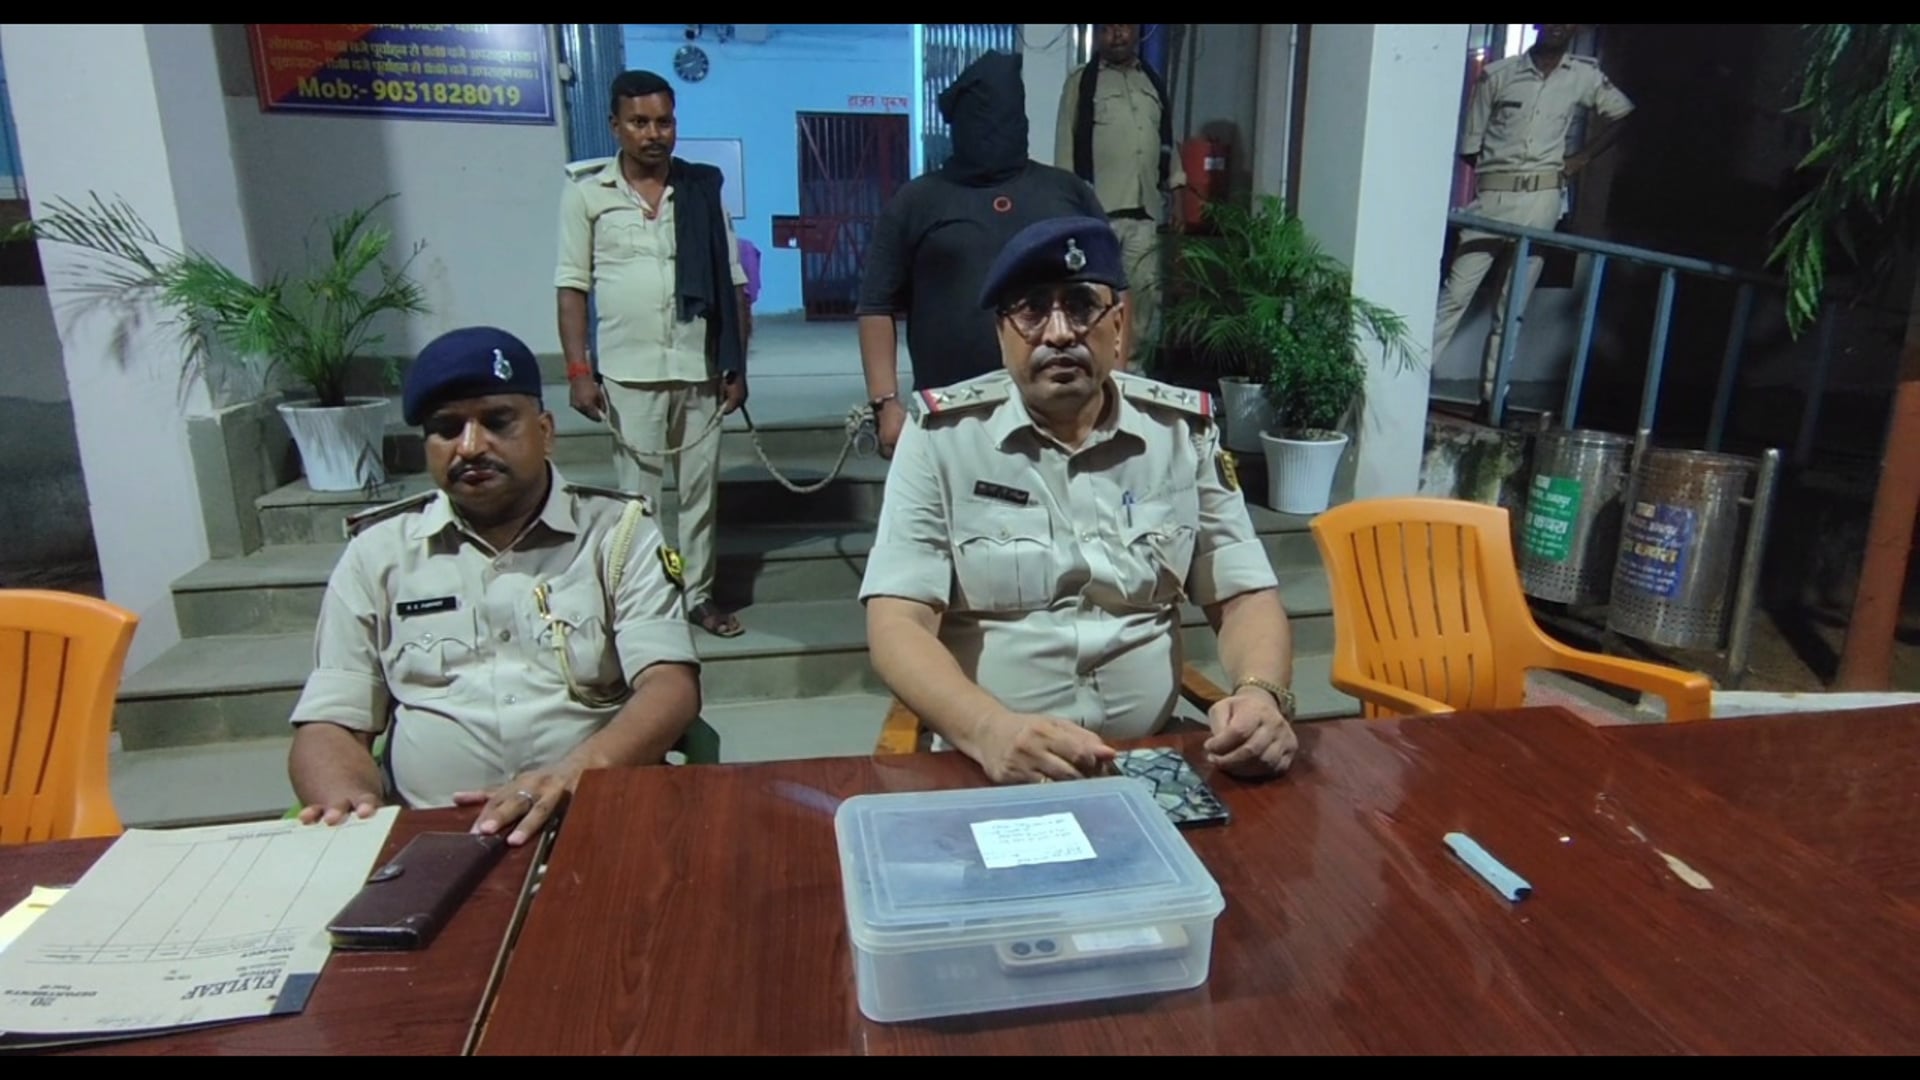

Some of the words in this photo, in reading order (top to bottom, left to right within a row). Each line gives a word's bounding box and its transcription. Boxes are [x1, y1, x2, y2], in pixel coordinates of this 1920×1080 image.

[298, 77, 368, 99] Mob:-
[372, 79, 521, 106] 9031828019
[180, 973, 282, 1001] FLYLEAF
